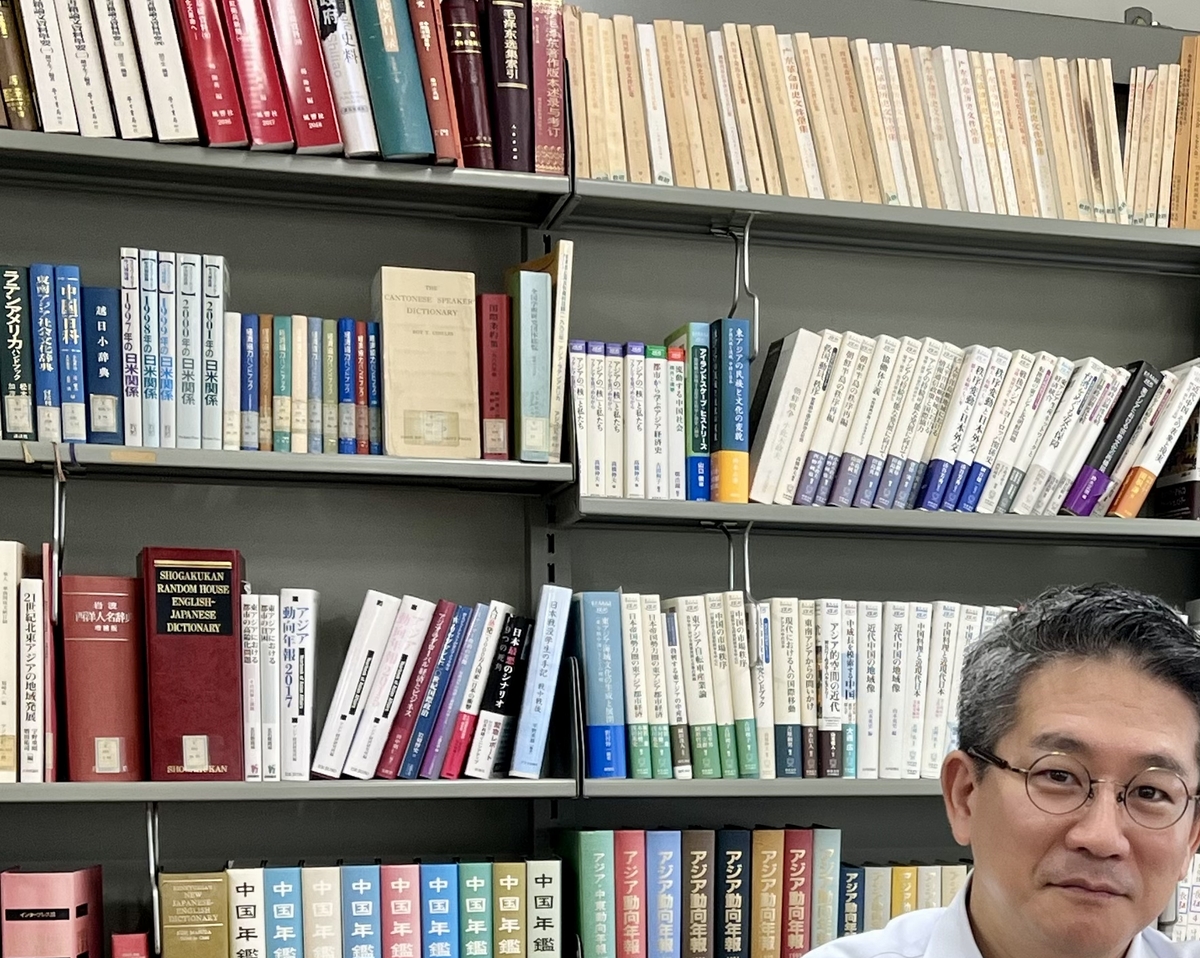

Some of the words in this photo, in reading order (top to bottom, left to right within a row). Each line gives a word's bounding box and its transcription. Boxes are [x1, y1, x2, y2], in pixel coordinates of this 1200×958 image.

[384, 294, 432, 303] CANTONESE
[406, 307, 458, 317] DICTIONARY
[95, 305, 110, 379] 越日小辞典
[157, 583, 197, 594] RANDOM
[199, 584, 230, 595] HOUSE
[159, 570, 225, 581] SHOGAKUKAN
[167, 622, 222, 633] DICTIONARY
[170, 610, 217, 620] JAPANESE
[296, 606, 309, 643] アジア
[715, 612, 728, 670] 中国の市場秩序
[735, 610, 748, 668] 中国の市場秩序
[24, 593, 37, 723] 21世紀北東アジアの地域発展
[829, 623, 841, 713] アジア的空間の近代
[866, 624, 876, 693] 近代中国の地域像
[891, 624, 903, 693] 近代中国の地域像
[168, 914, 218, 923] DICTIONARY
[390, 877, 413, 958] 中国年鑑
[428, 877, 451, 958] 中国年鑑
[465, 876, 488, 956] 中国年鑑
[498, 874, 521, 955] 中国年鑑
[533, 873, 555, 953] 中国年鑑
[657, 851, 673, 954] アジア動向年報
[689, 851, 708, 954] アジア動向年報
[724, 851, 742, 952] アジア動向年報
[760, 851, 777, 951] アジア動向年報
[787, 849, 806, 950] アジア動向年報
